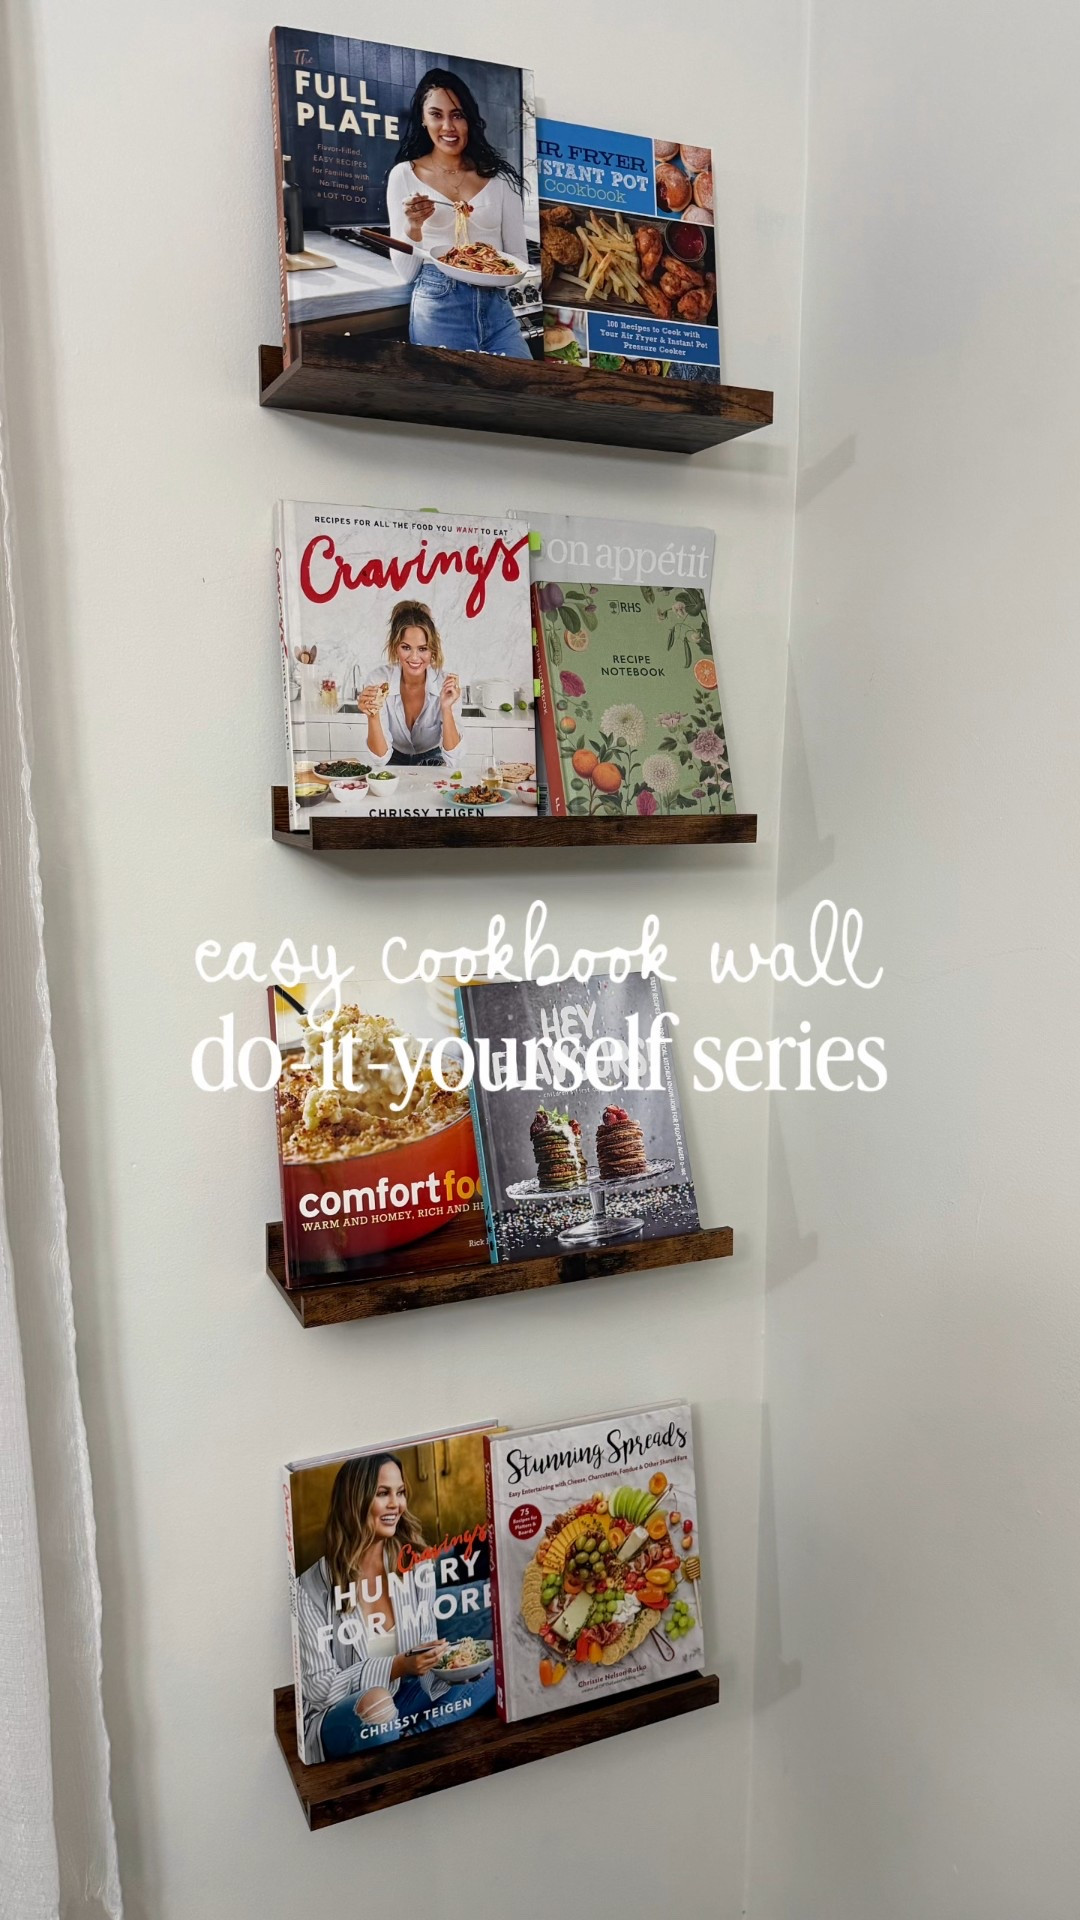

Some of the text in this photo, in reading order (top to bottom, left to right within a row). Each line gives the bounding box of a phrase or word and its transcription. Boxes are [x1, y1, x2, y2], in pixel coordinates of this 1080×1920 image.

[294, 48, 314, 65] The
[295, 69, 376, 106] FULL
[296, 101, 400, 141] PLATE
[313, 154, 368, 169] EASY RECIPES
[567, 144, 648, 174] FRYER
[312, 165, 370, 181] for Families with
[537, 158, 649, 192] STANT POT
[319, 179, 364, 192] No Time and
[544, 178, 628, 204] Cookbook
[323, 191, 339, 200] LOT
[341, 194, 353, 202] TO
[354, 196, 367, 204] DO
[600, 328, 708, 349] Your Air Fryer & Instant Pot
[607, 319, 619, 329] 100
[620, 321, 651, 333] Recipes
[661, 328, 682, 337] Cook
[683, 330, 701, 339] with
[623, 341, 686, 356] Pressure Cooker
[314, 515, 351, 525] RECIPES
[354, 518, 371, 527] FOR
[374, 519, 390, 528] ALL
[392, 521, 409, 530] THE
[411, 522, 434, 532] FOOD
[436, 524, 453, 533] YOU
[455, 526, 479, 535] WANT
[493, 528, 508, 537] EAT
[535, 538, 710, 584] on appétit
[299, 534, 529, 619] Cravings
[620, 602, 642, 614] RHS
[612, 654, 651, 665] RECIPE
[601, 667, 666, 678] NOTEBOOK
[369, 807, 430, 817] CHRISSY
[540, 1001, 597, 1042] HEY
[671, 1111, 679, 1124] FOR
[673, 1123, 683, 1146] PEOPLE
[676, 1144, 685, 1163] AGED
[302, 1221, 340, 1232] WARM
[343, 1216, 369, 1228] AND
[371, 1211, 415, 1224] HOMEY,
[417, 1206, 444, 1219] RICH
[447, 1203, 470, 1216] AND
[469, 1238, 485, 1248] Rick
[506, 1421, 688, 1485] Stunning Spreads
[508, 1490, 521, 1499] Easy
[521, 1483, 555, 1496] Entertaining
[554, 1480, 567, 1489] with
[566, 1477, 588, 1487] Cheese,
[587, 1470, 619, 1483] Charcuterie,
[619, 1464, 638, 1475] Fondue
[643, 1461, 660, 1470] Other
[659, 1457, 677, 1467] Shared
[677, 1454, 688, 1462] Fare
[512, 1517, 530, 1525] Recipes
[520, 1507, 530, 1517] 75
[514, 1523, 532, 1531] Platters
[518, 1528, 534, 1536] Boards
[397, 1522, 488, 1574] Cravings
[334, 1550, 481, 1611] HUNGRY
[317, 1612, 388, 1654] FOR
[402, 1583, 492, 1632] MORE
[577, 1676, 604, 1688] Chrissie
[360, 1697, 472, 1740] CHRISSY TEIGEN
